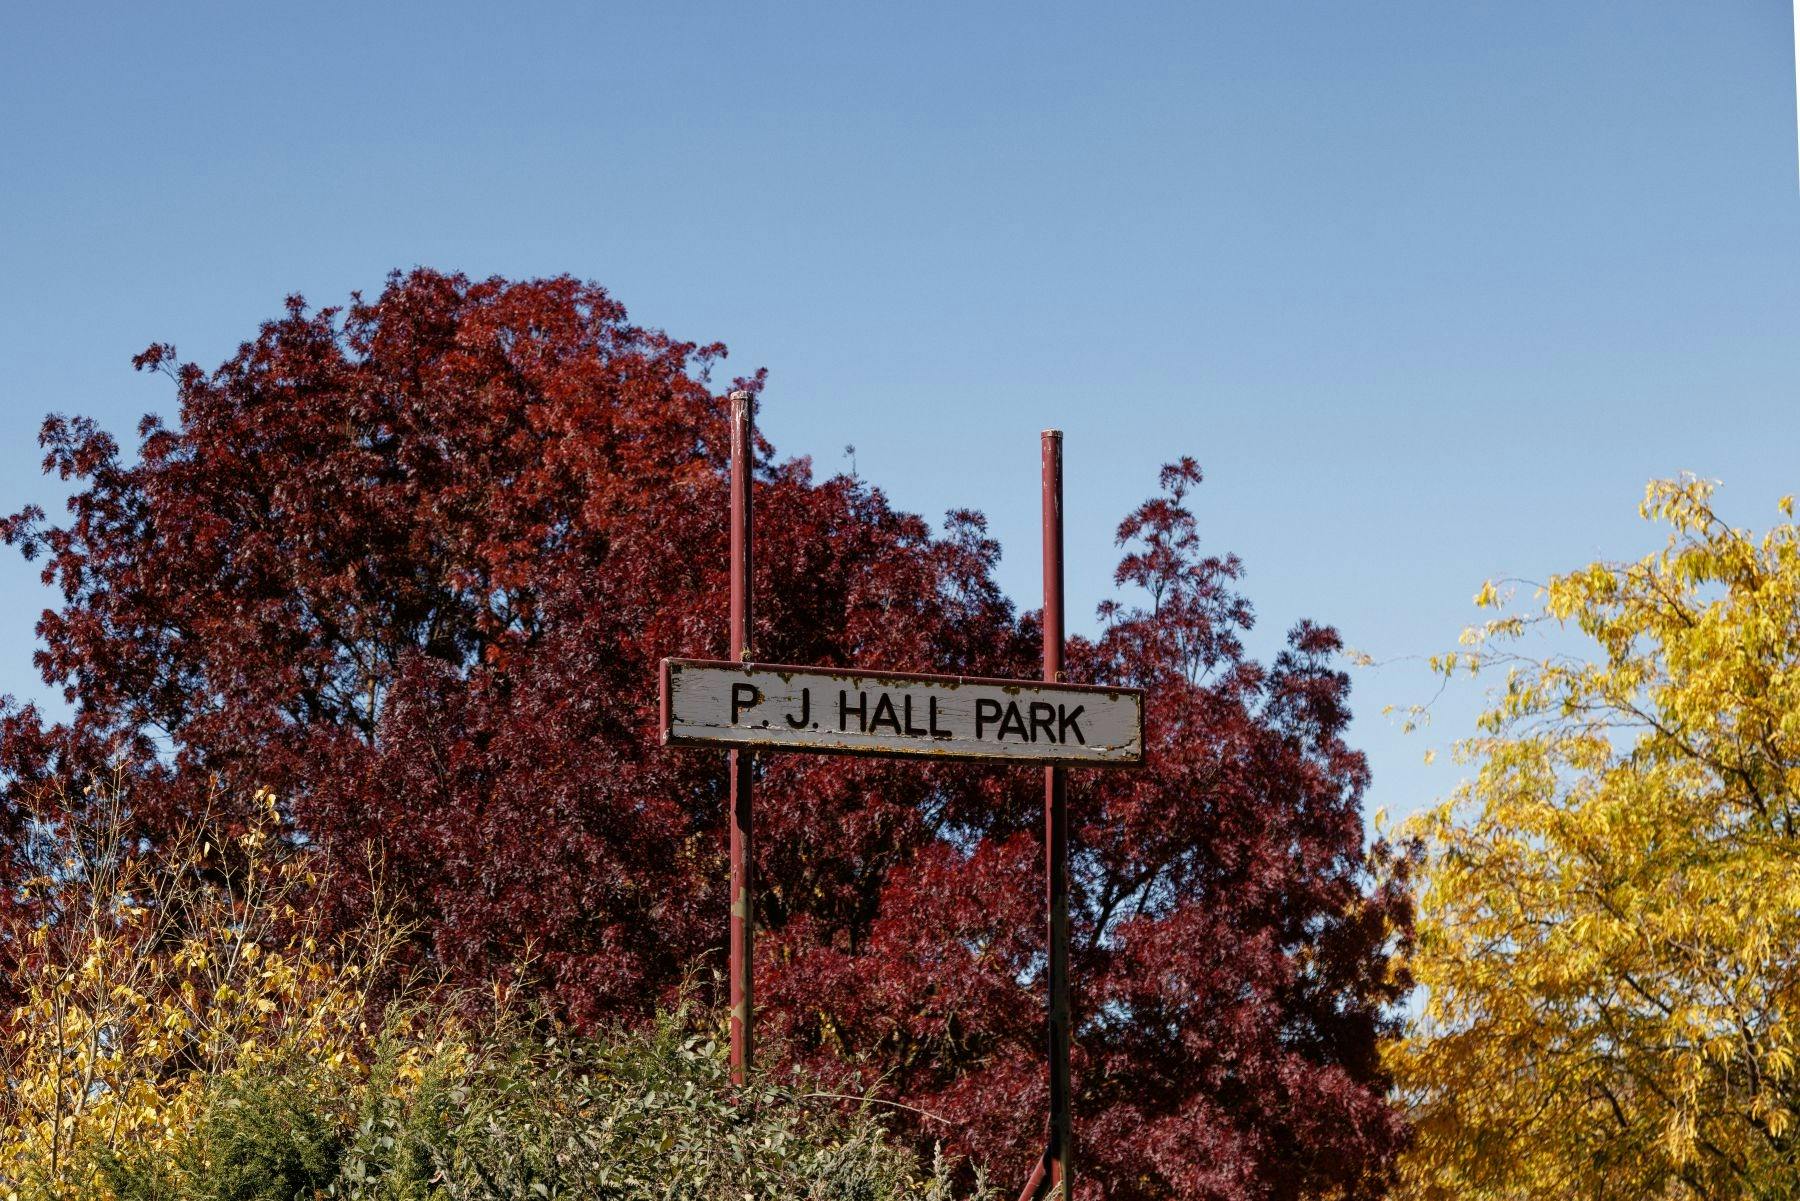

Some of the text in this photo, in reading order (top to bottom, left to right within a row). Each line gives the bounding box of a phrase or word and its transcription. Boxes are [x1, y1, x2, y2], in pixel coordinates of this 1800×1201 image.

[730, 682, 1086, 746] P. J. HALL PARK
